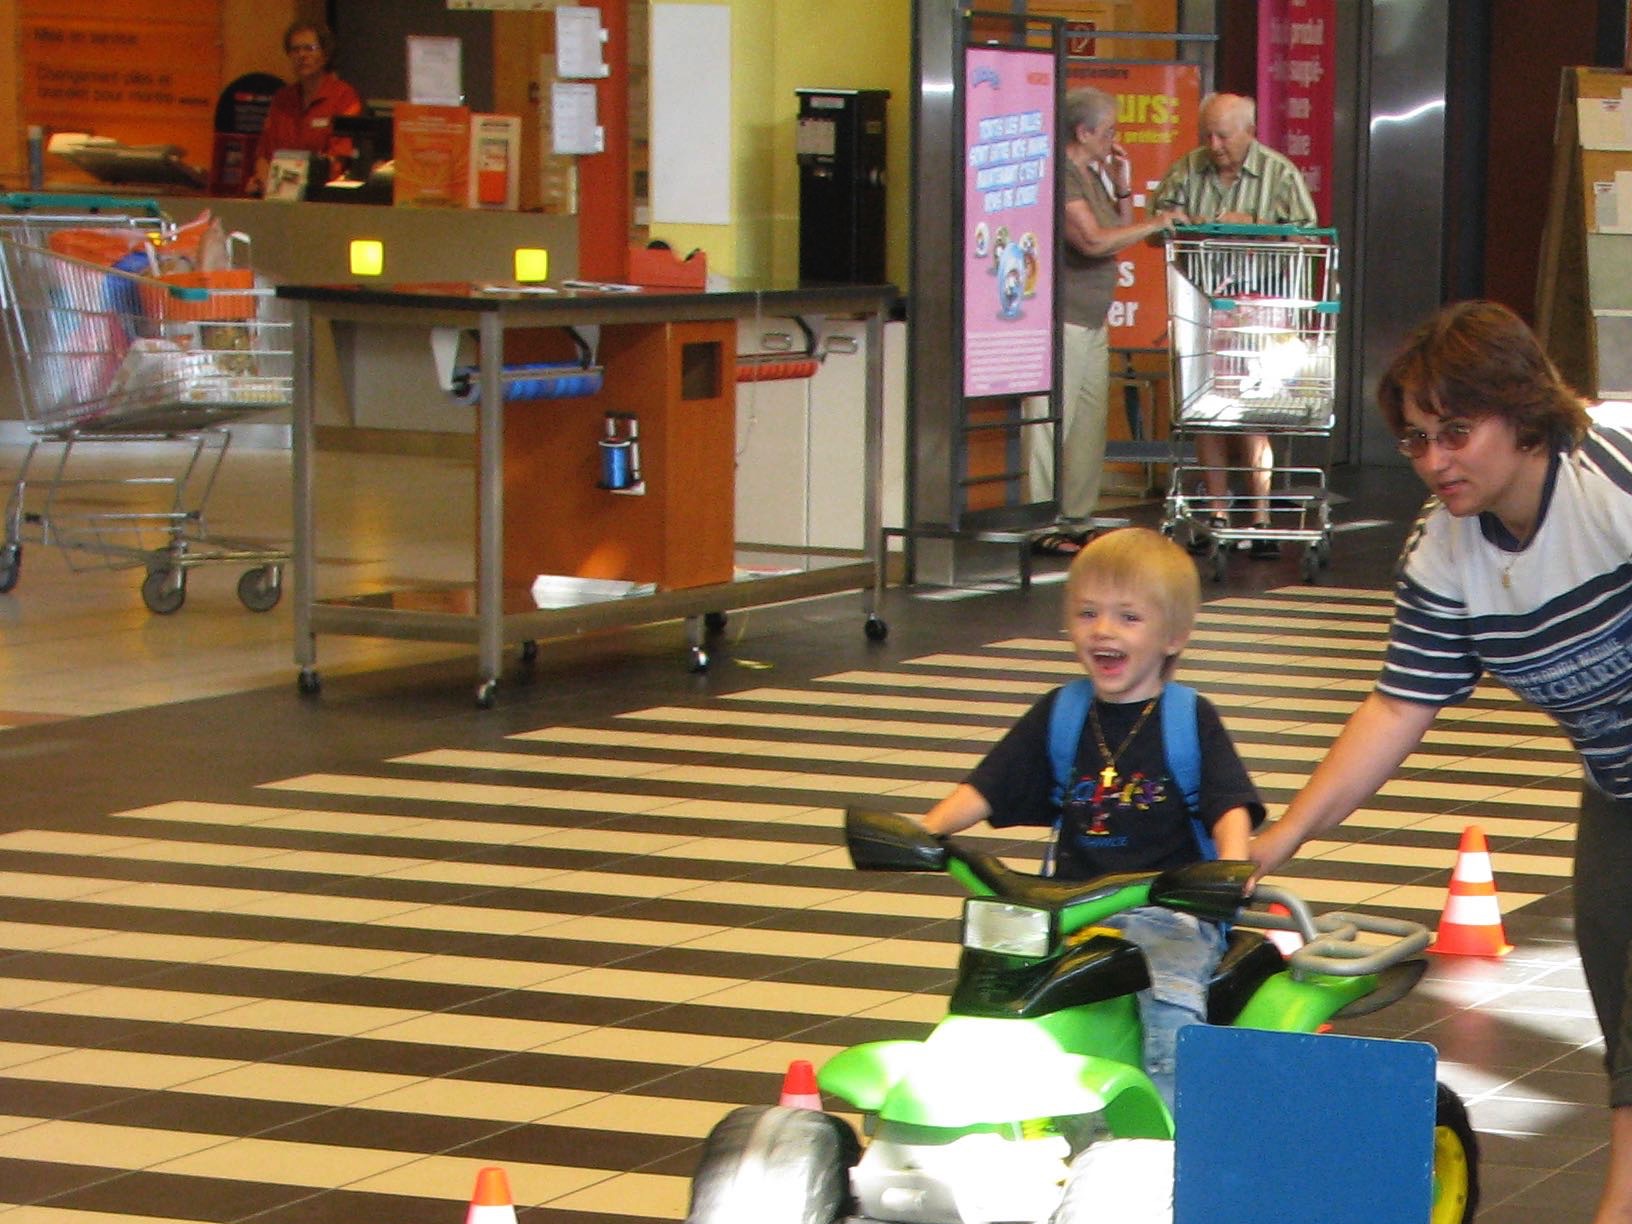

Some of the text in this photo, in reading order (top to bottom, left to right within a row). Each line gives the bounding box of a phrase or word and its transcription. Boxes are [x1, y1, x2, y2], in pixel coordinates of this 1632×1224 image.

[1115, 94, 1180, 124] urs:
[1118, 261, 1136, 288] s
[1107, 301, 1139, 327] er
